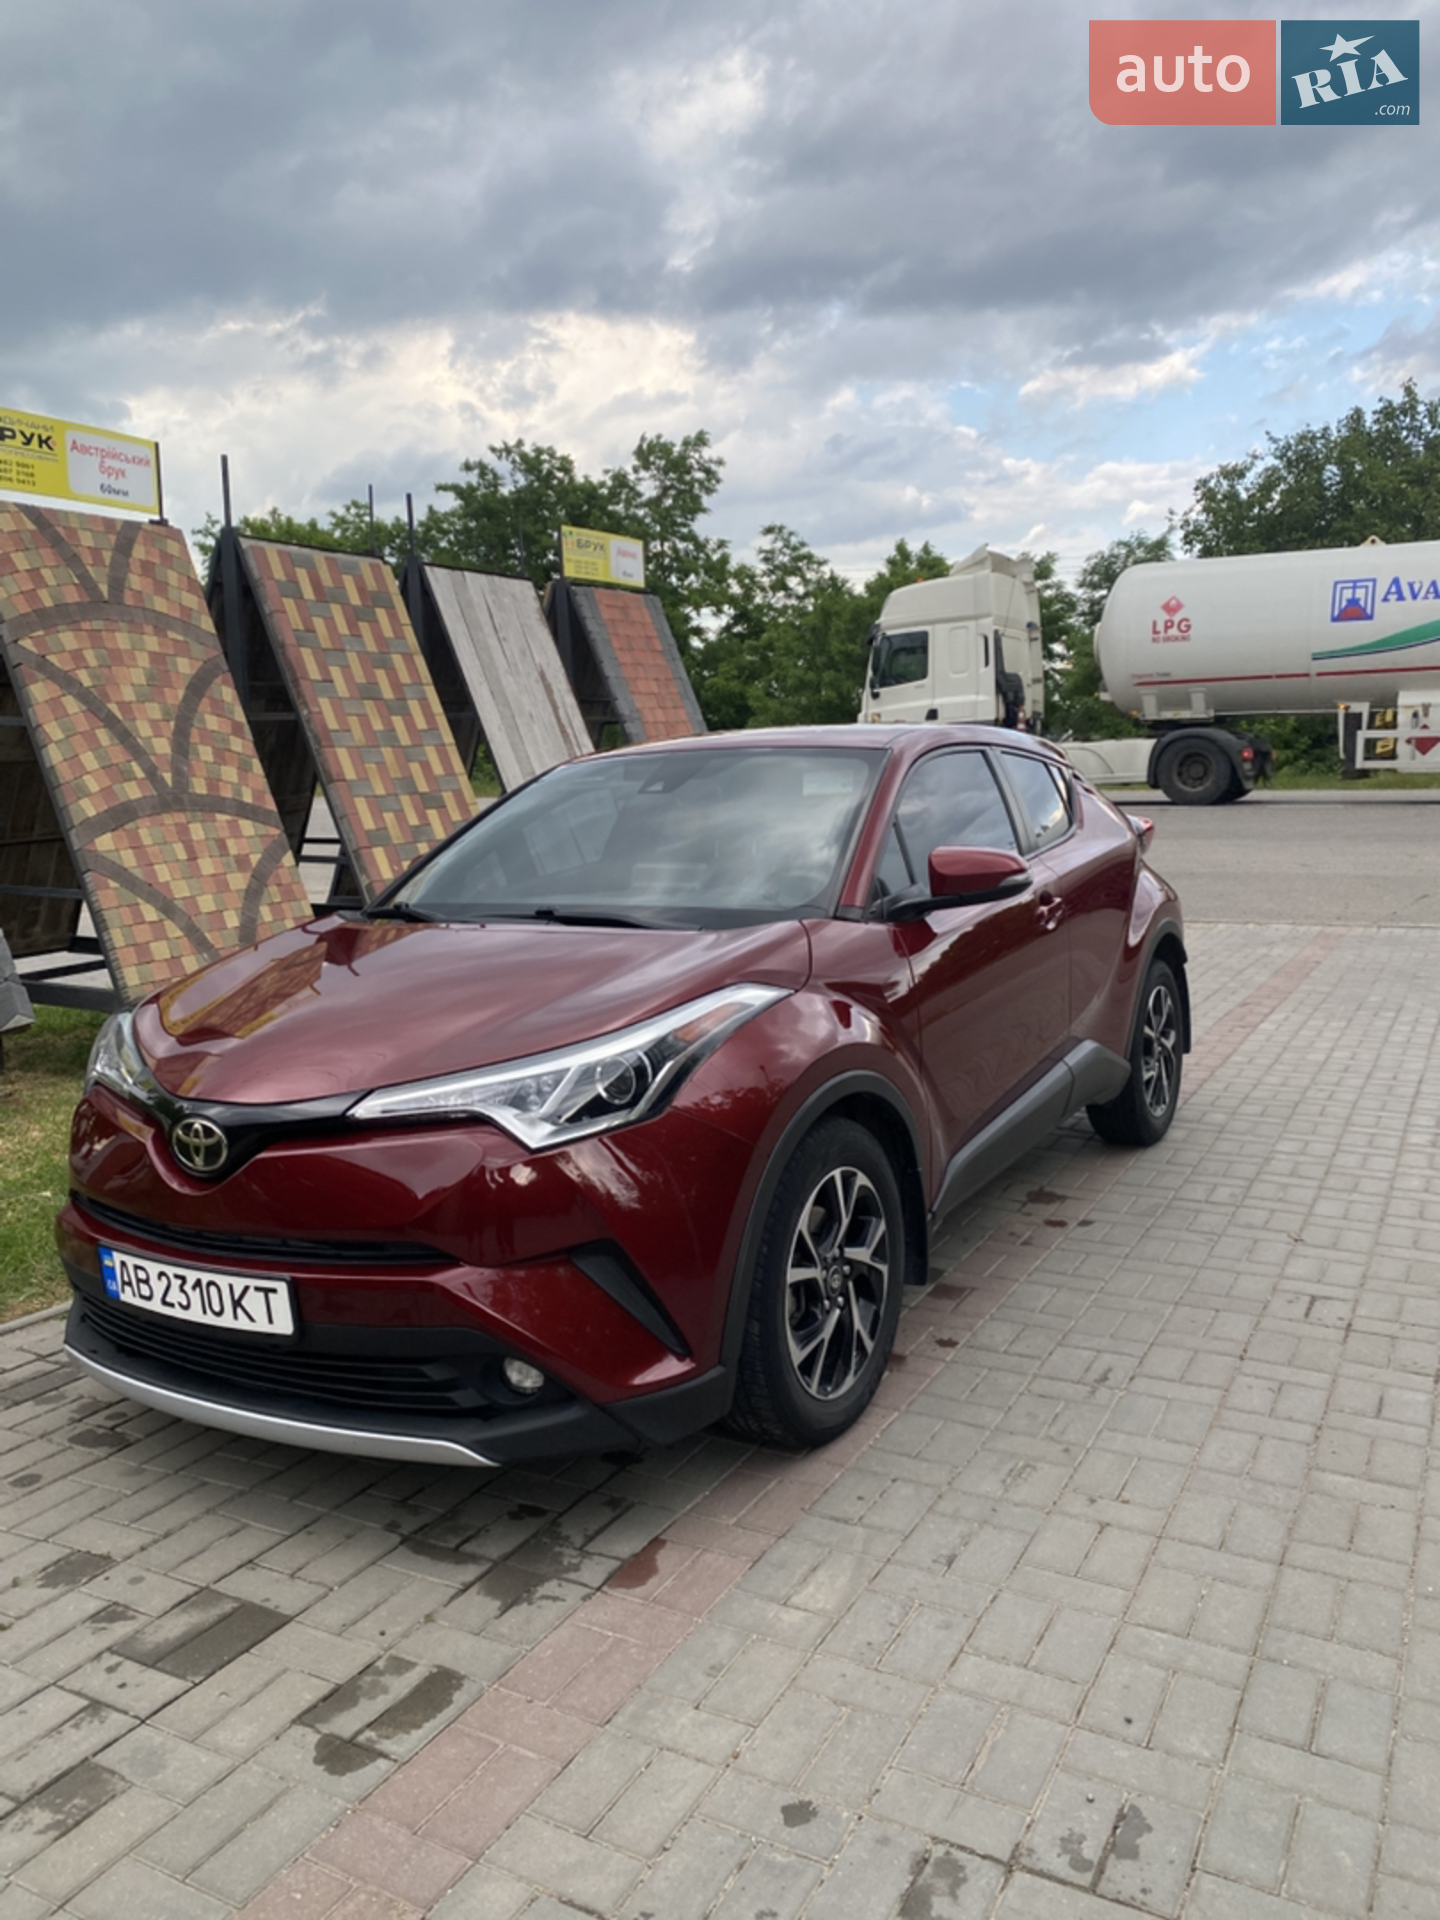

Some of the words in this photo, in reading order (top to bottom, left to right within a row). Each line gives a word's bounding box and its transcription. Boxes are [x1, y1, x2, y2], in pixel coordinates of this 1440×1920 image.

[1152, 617, 1192, 635] LPG
[157, 1270, 225, 1318] 2310
[228, 1283, 278, 1325] KT
